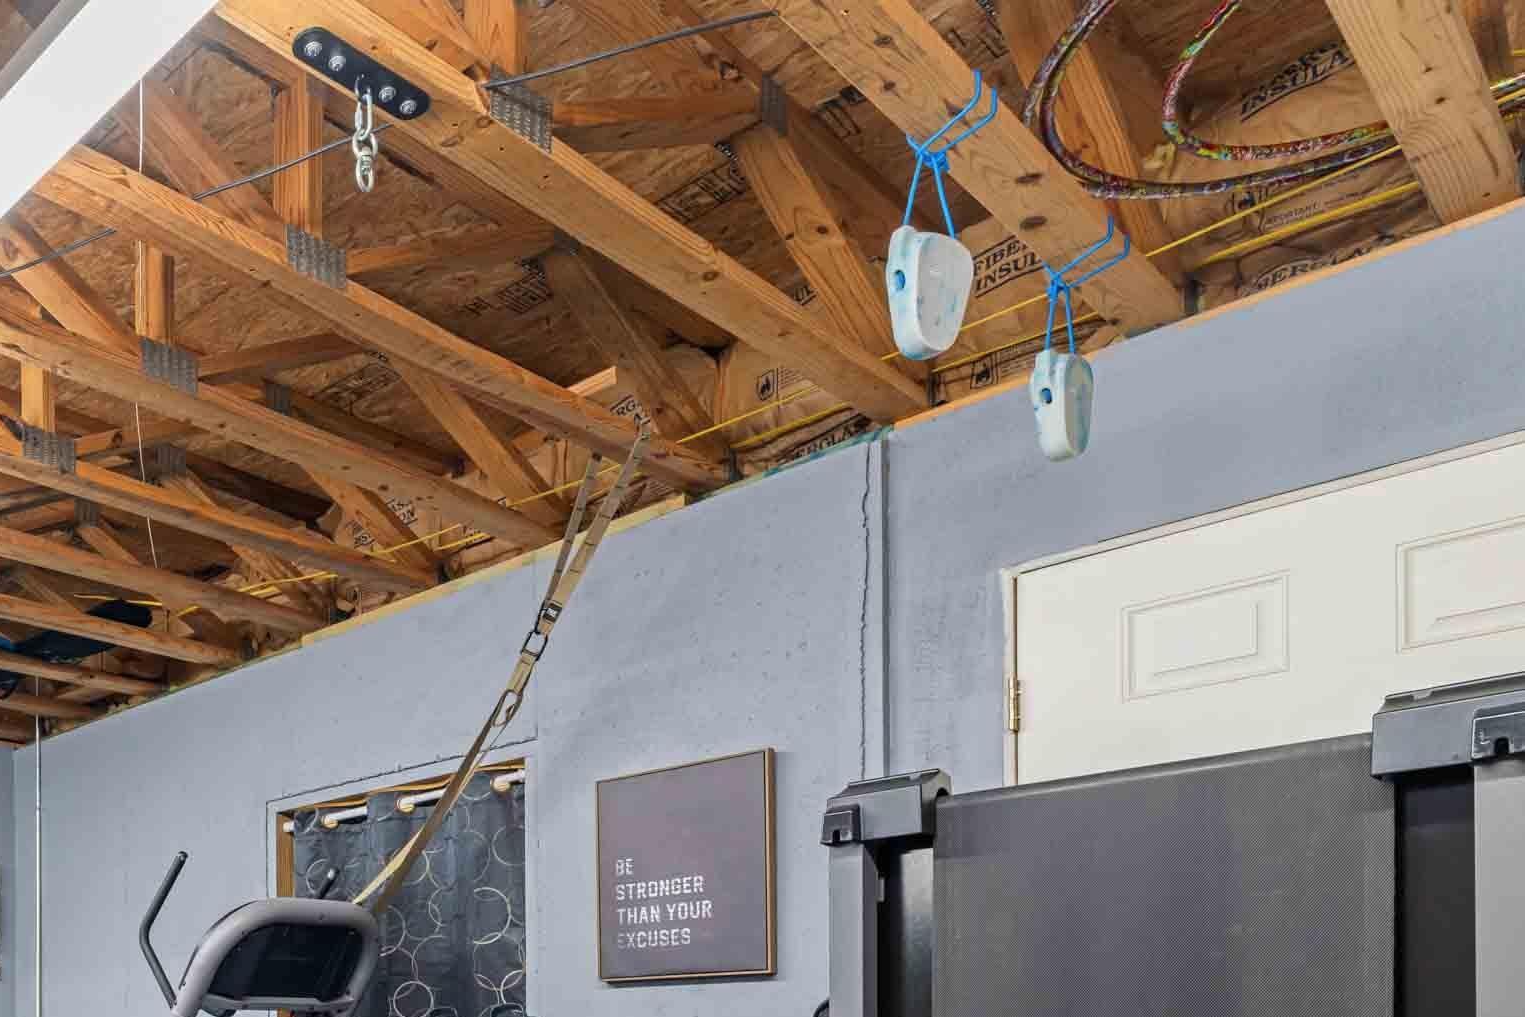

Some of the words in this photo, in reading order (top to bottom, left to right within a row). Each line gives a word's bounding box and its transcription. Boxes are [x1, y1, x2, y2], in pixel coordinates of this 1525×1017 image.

[616, 858, 634, 875] BE
[616, 875, 705, 901] STRONGER
[617, 903, 661, 925] THAN
[666, 899, 714, 921] YOUR
